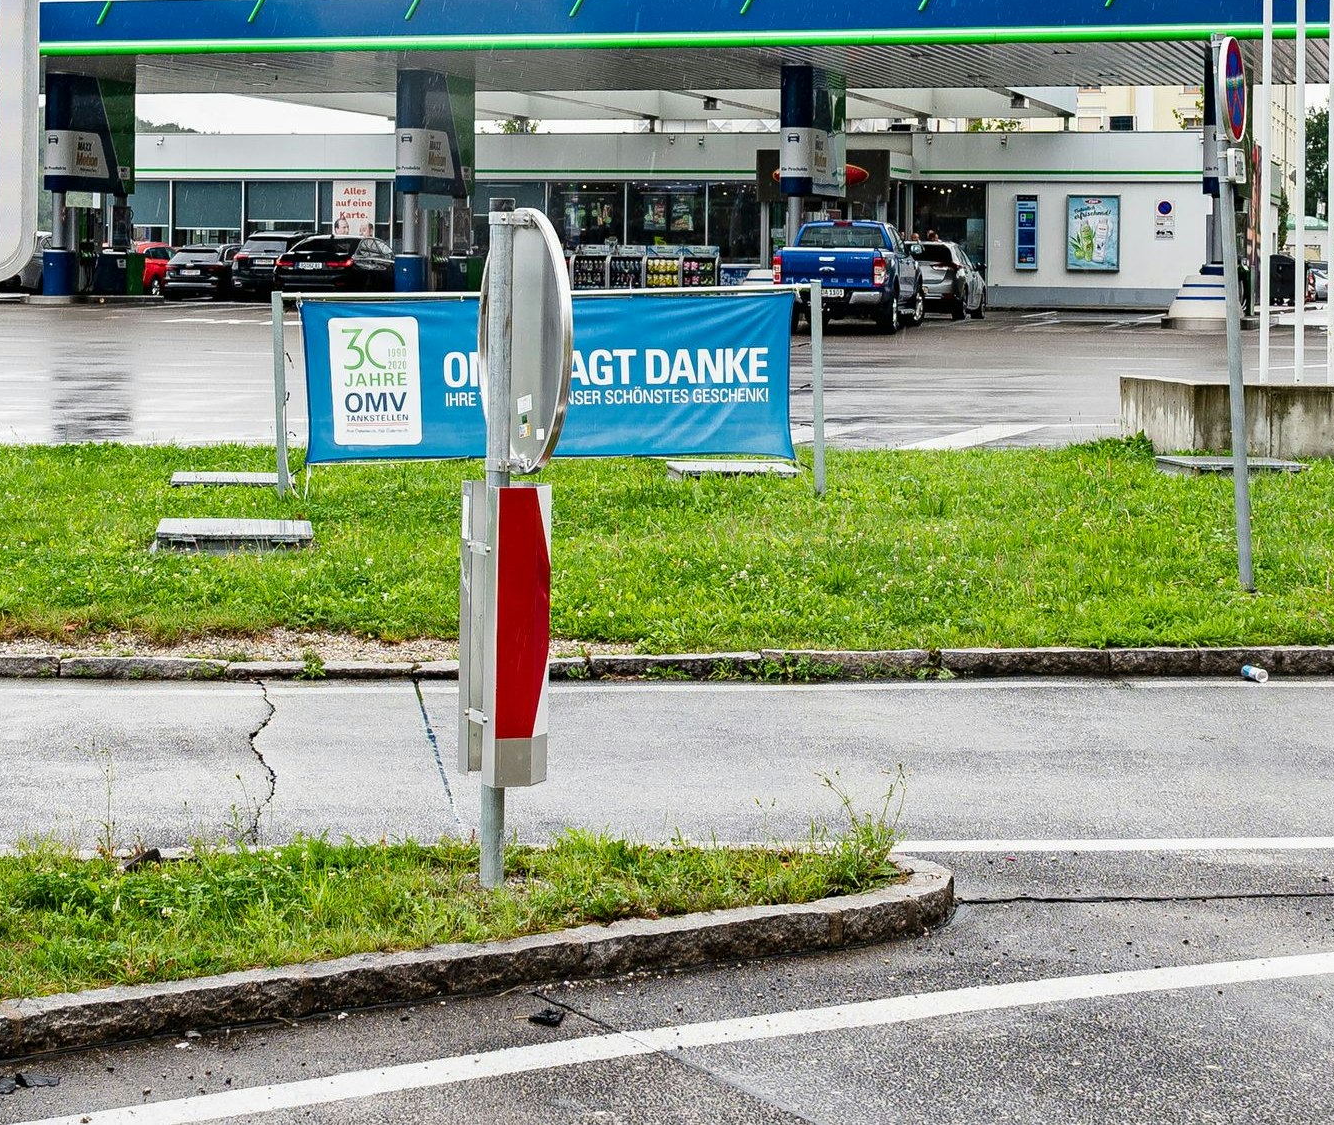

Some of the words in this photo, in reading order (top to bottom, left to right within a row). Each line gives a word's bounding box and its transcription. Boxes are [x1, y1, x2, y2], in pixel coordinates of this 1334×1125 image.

[335, 199, 351, 207] auf
[353, 198, 373, 207] eine
[342, 328, 405, 370] 30
[388, 360, 407, 370] 2020
[571, 349, 637, 386] AGT
[645, 347, 769, 385] DANKE
[344, 372, 408, 387] JAHRE
[345, 392, 407, 413] OMV
[445, 391, 477, 407] IHRE
[568, 390, 601, 405] NSER
[604, 386, 690, 405] SCHÖNSTES
[692, 387, 769, 404] GESCHENK!
[346, 414, 409, 423] TANKSTELLEN
